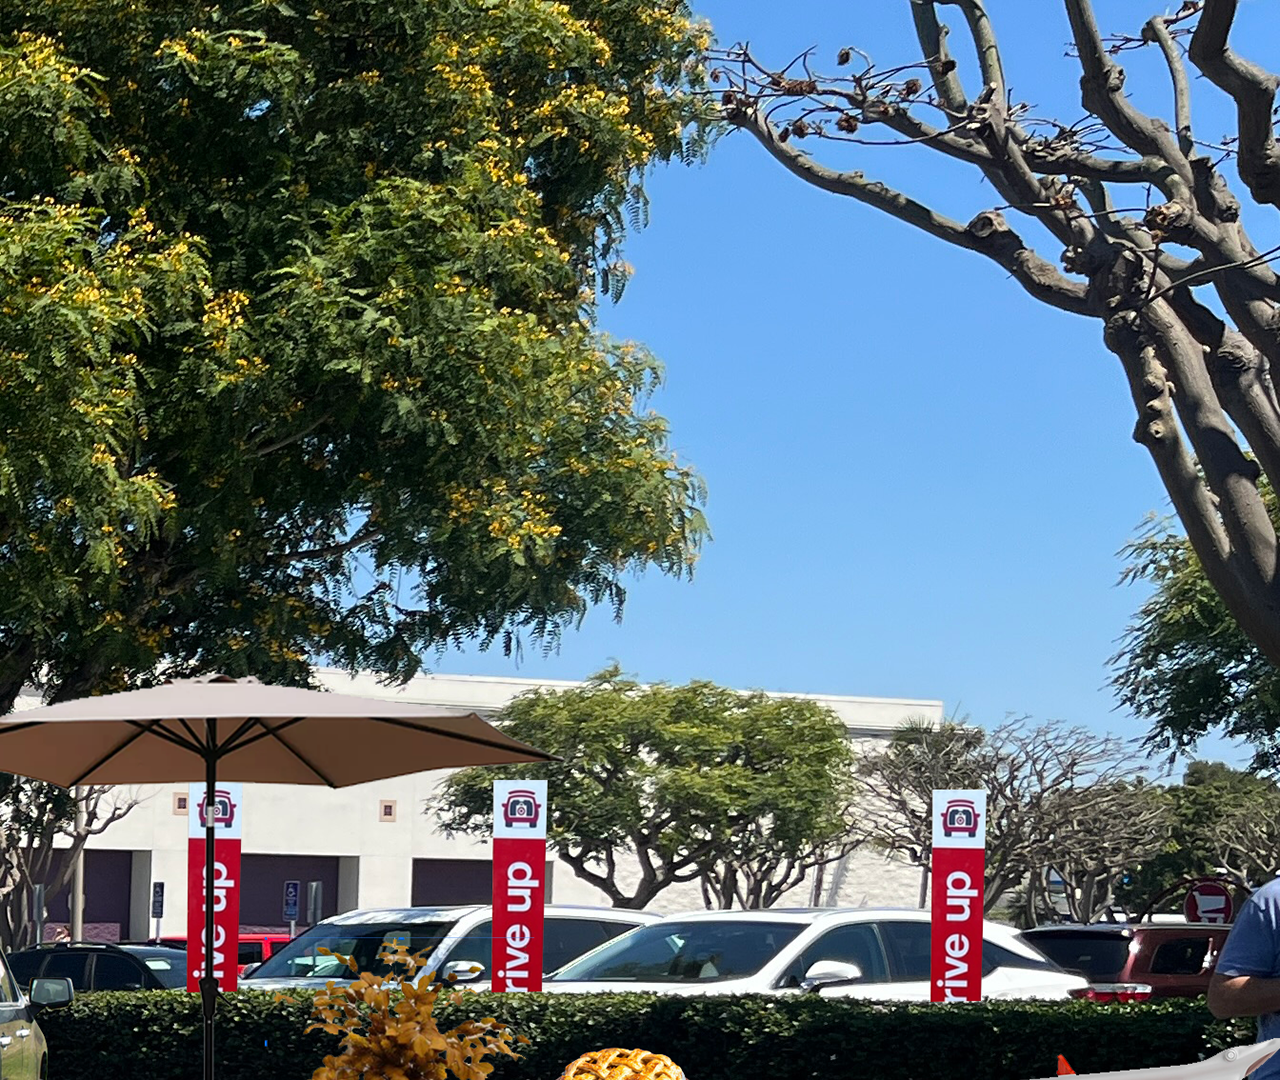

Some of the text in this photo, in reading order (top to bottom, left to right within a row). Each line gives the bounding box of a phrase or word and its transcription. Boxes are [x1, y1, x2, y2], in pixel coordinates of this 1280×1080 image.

[202, 861, 235, 912] up
[506, 861, 539, 912] up
[945, 871, 979, 922] up
